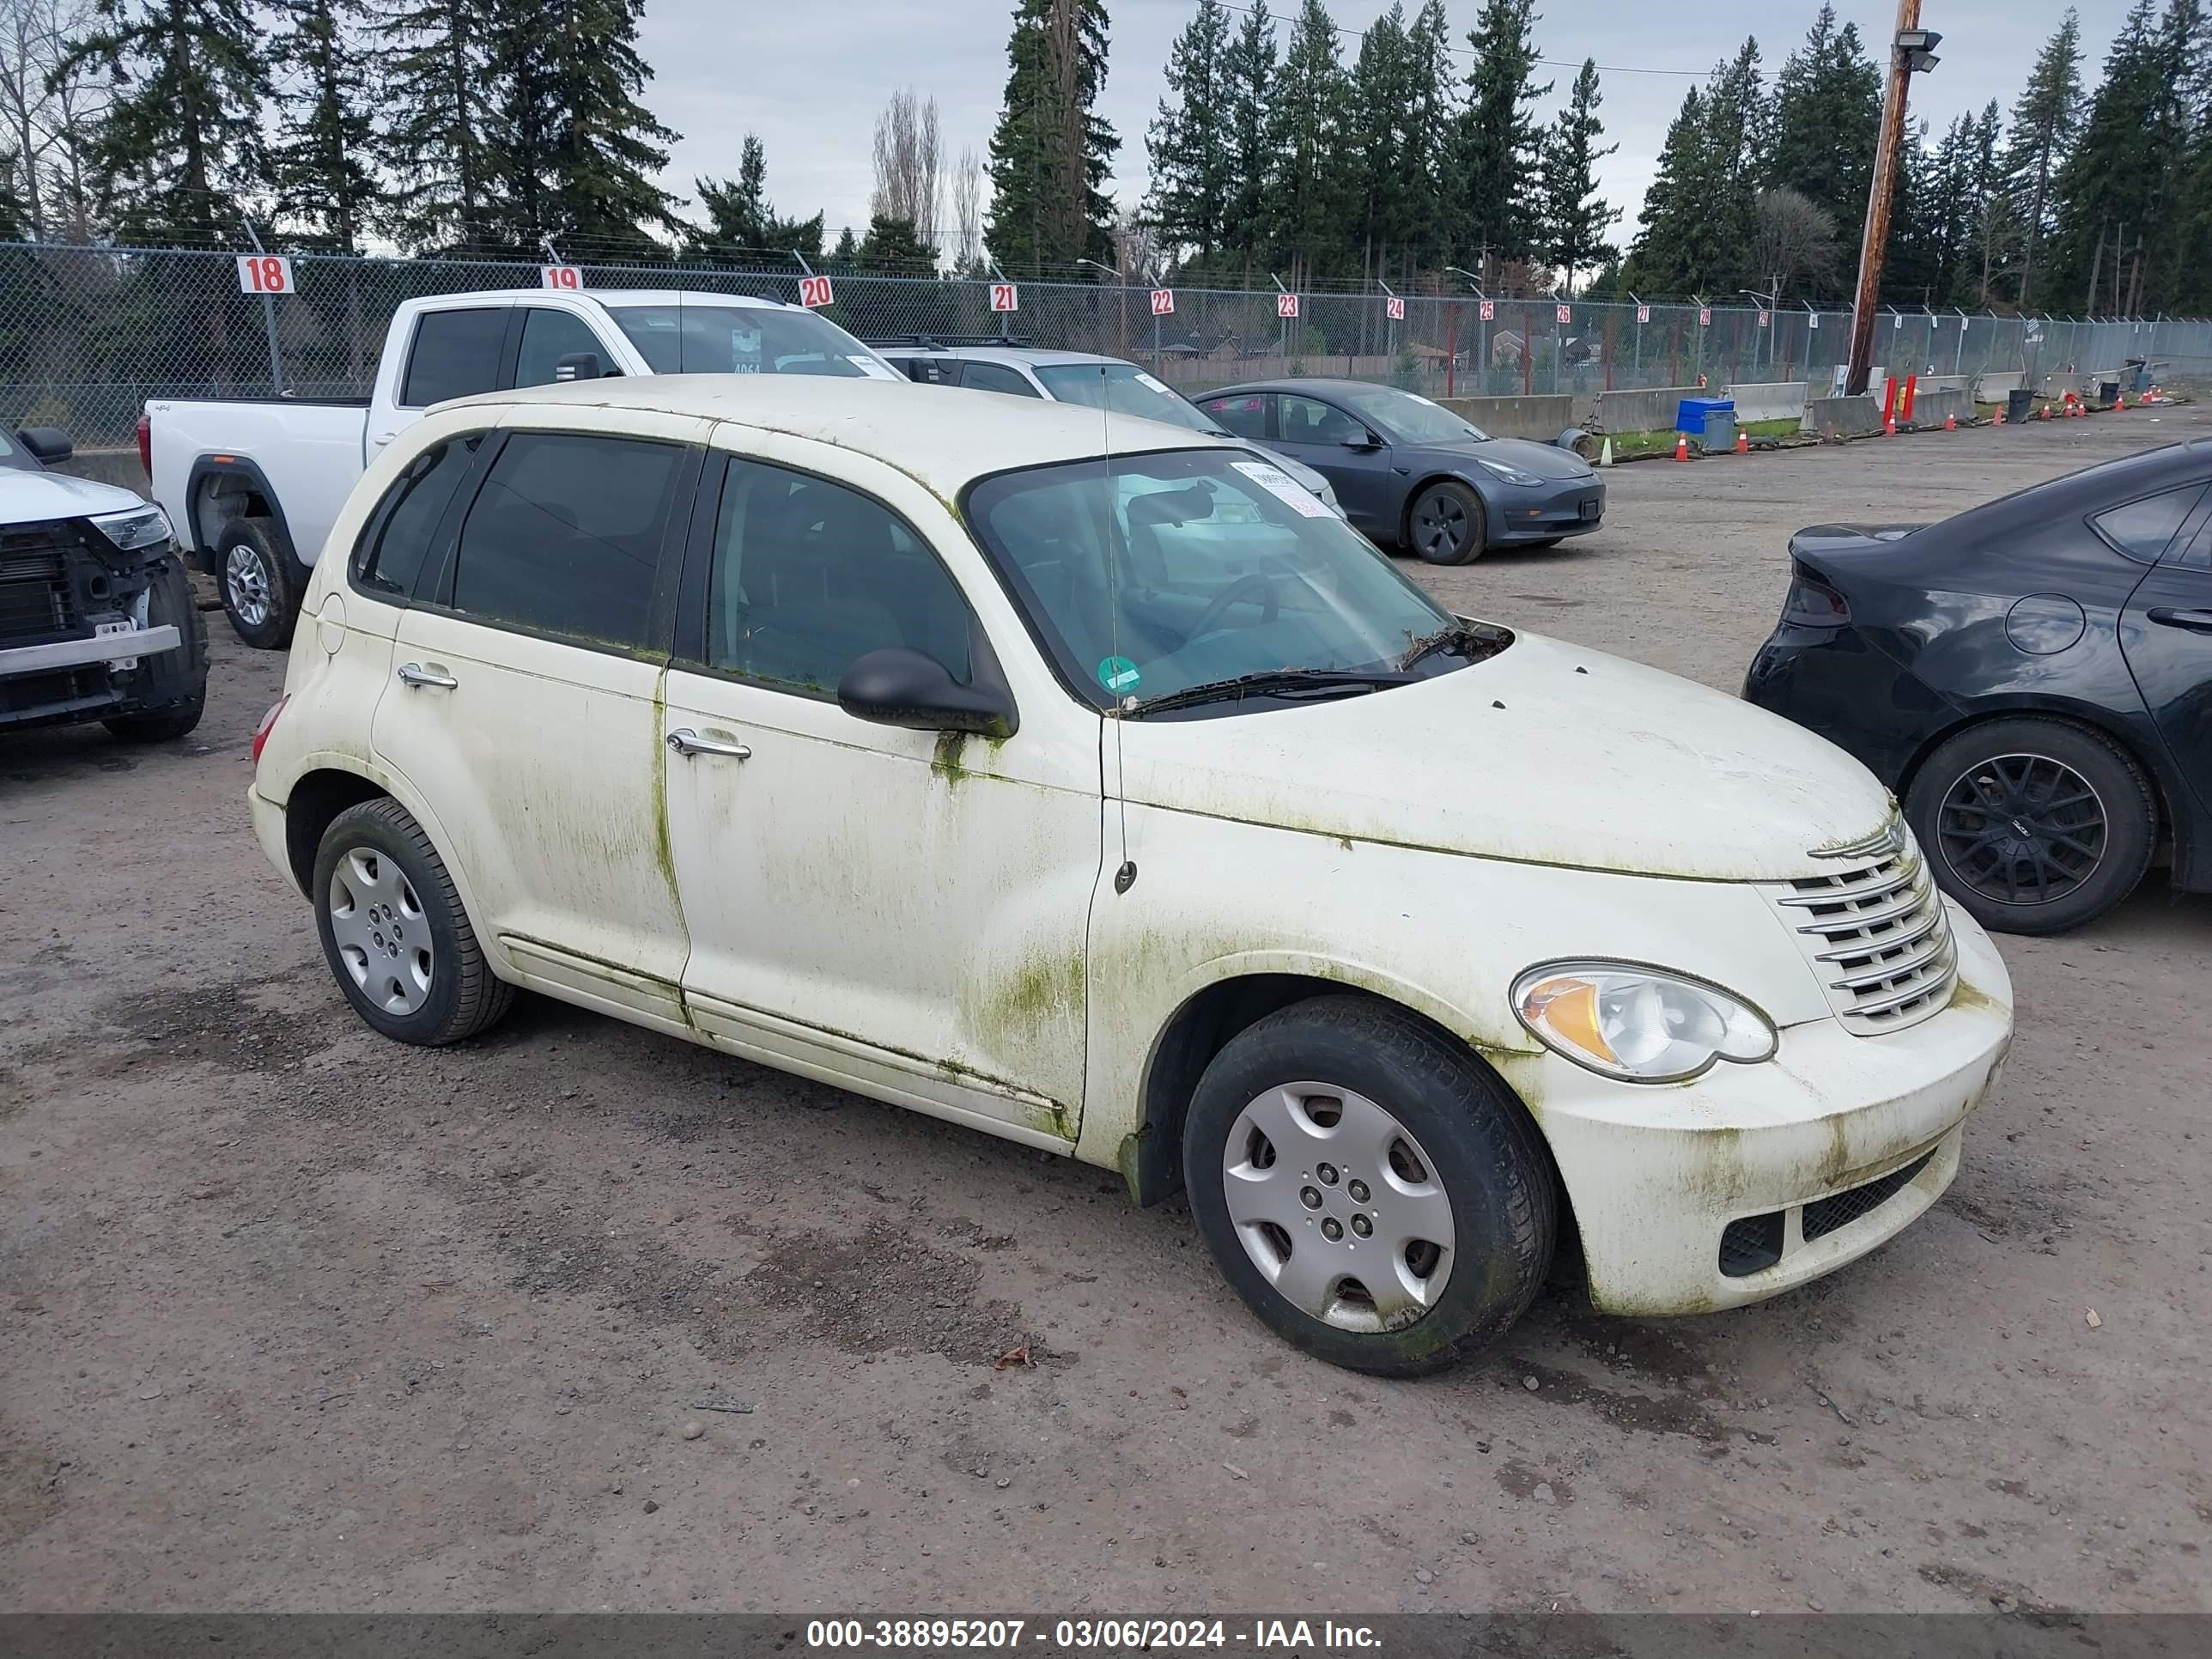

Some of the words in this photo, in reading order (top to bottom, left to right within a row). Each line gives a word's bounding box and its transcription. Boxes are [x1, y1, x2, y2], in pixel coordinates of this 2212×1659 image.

[246, 258, 284, 291] 18
[548, 268, 578, 289] 19
[802, 277, 830, 306] 20
[994, 286, 1012, 309] 21
[1153, 290, 1172, 313] 22
[1280, 296, 1296, 315] 23
[1389, 299, 1402, 318] 24
[1481, 302, 1492, 319] 25
[1559, 307, 1569, 322] 26
[1638, 307, 1648, 322] 27
[1701, 310, 1710, 324] 28
